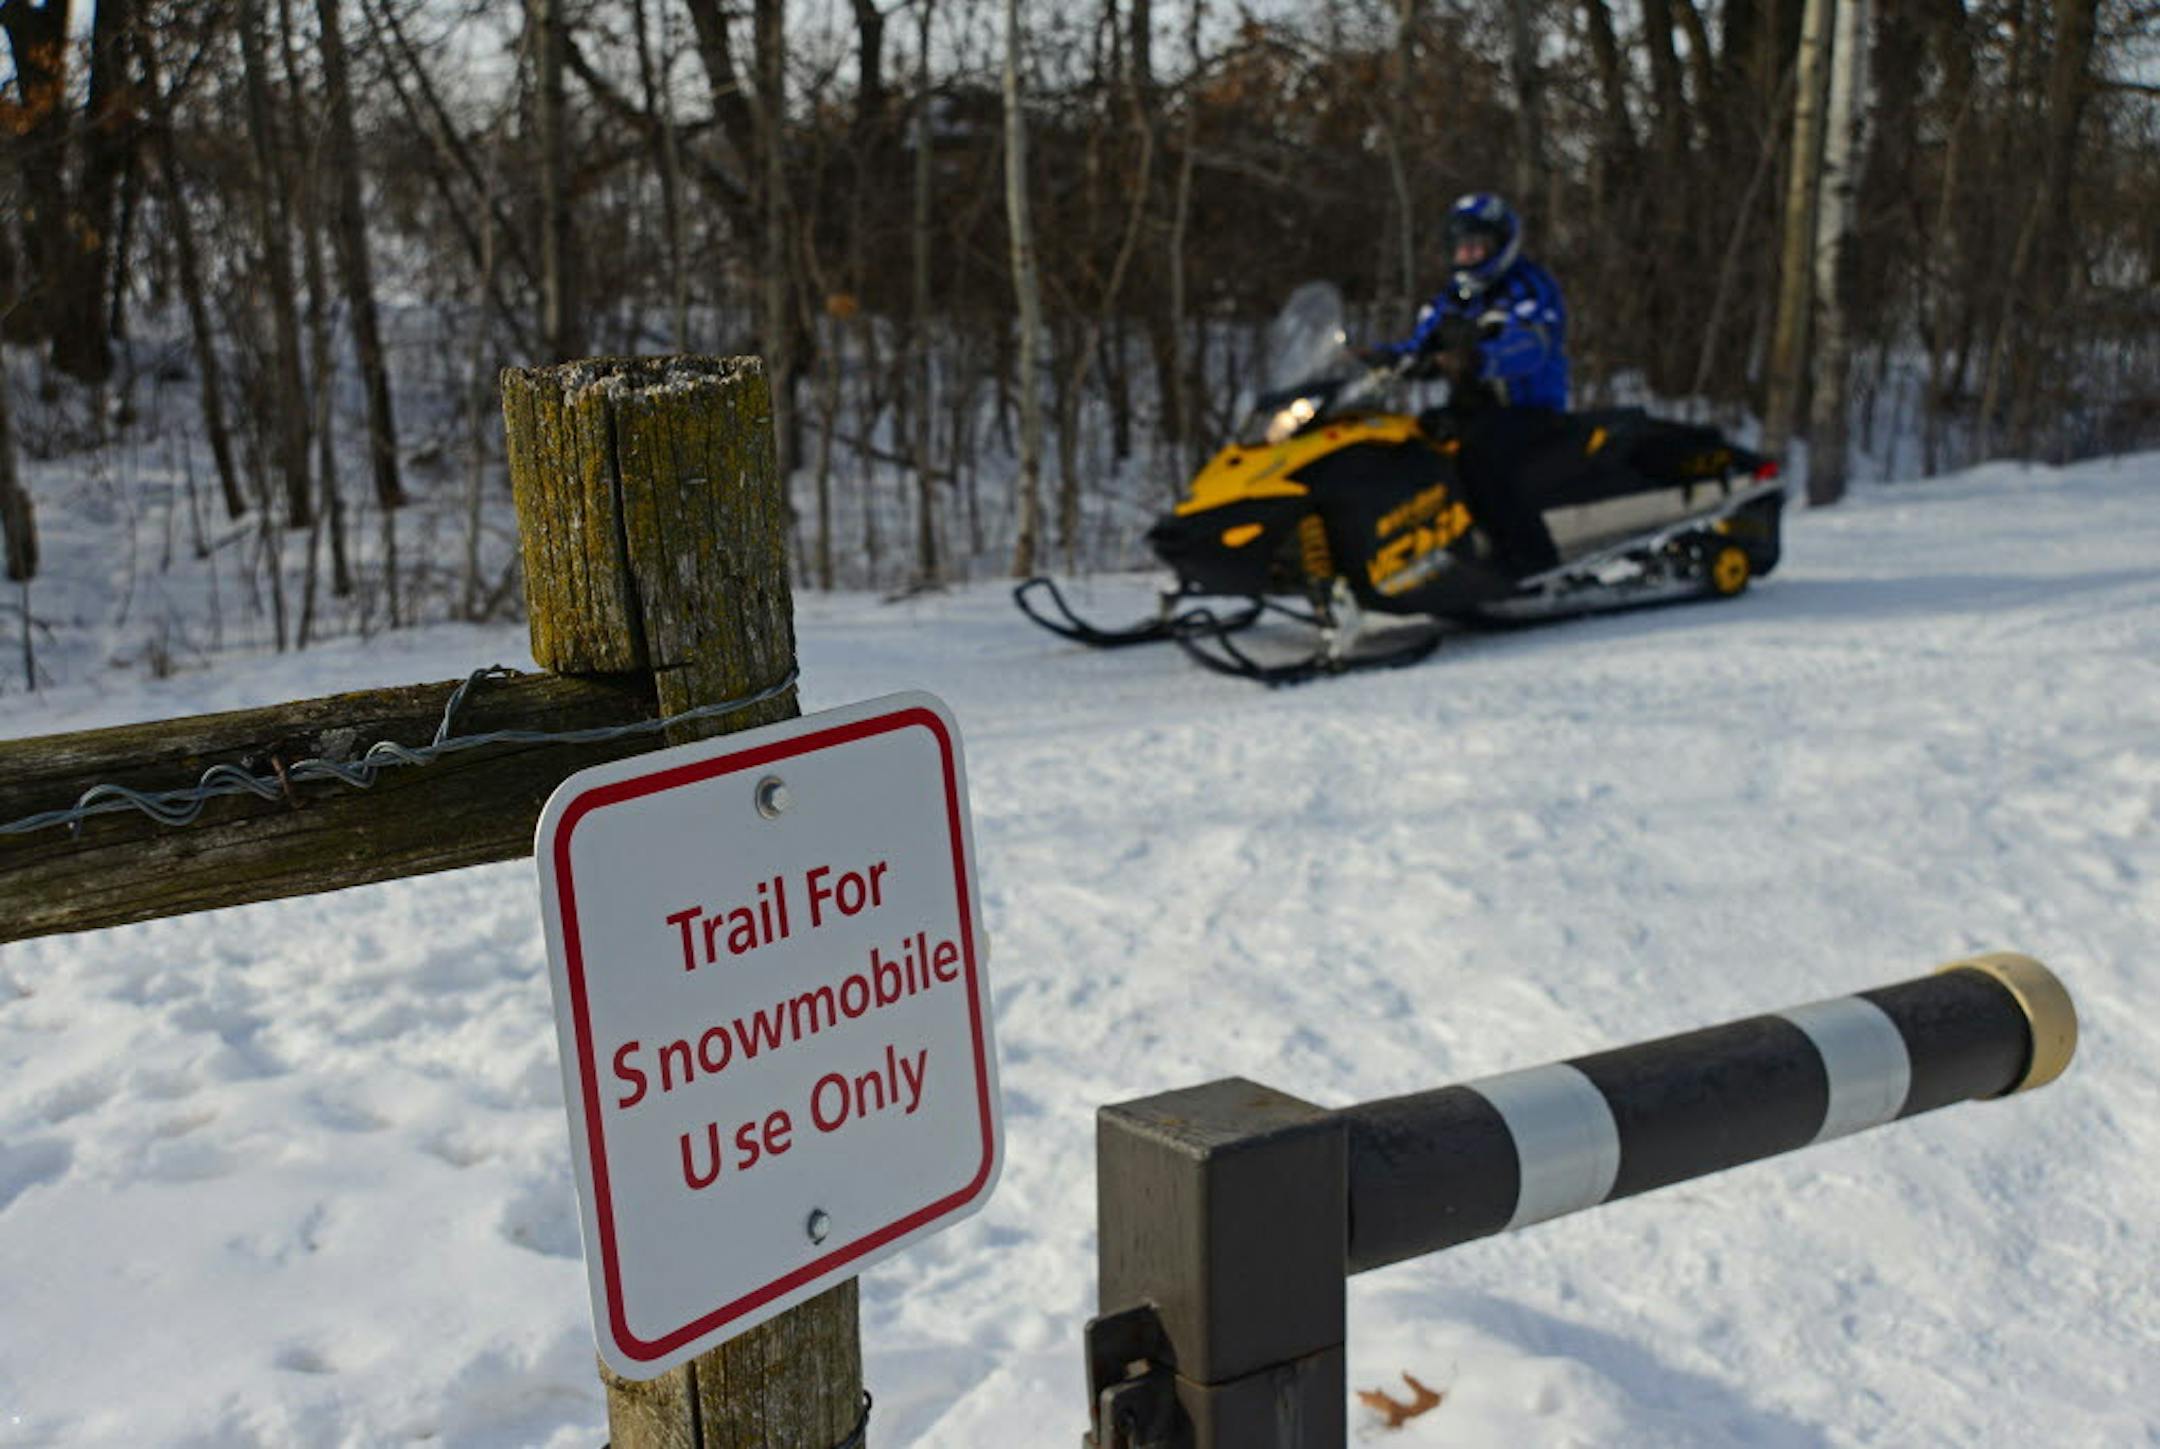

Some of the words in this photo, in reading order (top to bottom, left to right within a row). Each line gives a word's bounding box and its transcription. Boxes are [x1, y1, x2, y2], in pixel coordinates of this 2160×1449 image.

[665, 876, 790, 972] Trail
[805, 860, 887, 927] For
[613, 931, 961, 1109] Snowmobile
[680, 1109, 792, 1191] Use
[810, 1044, 927, 1133] Only
